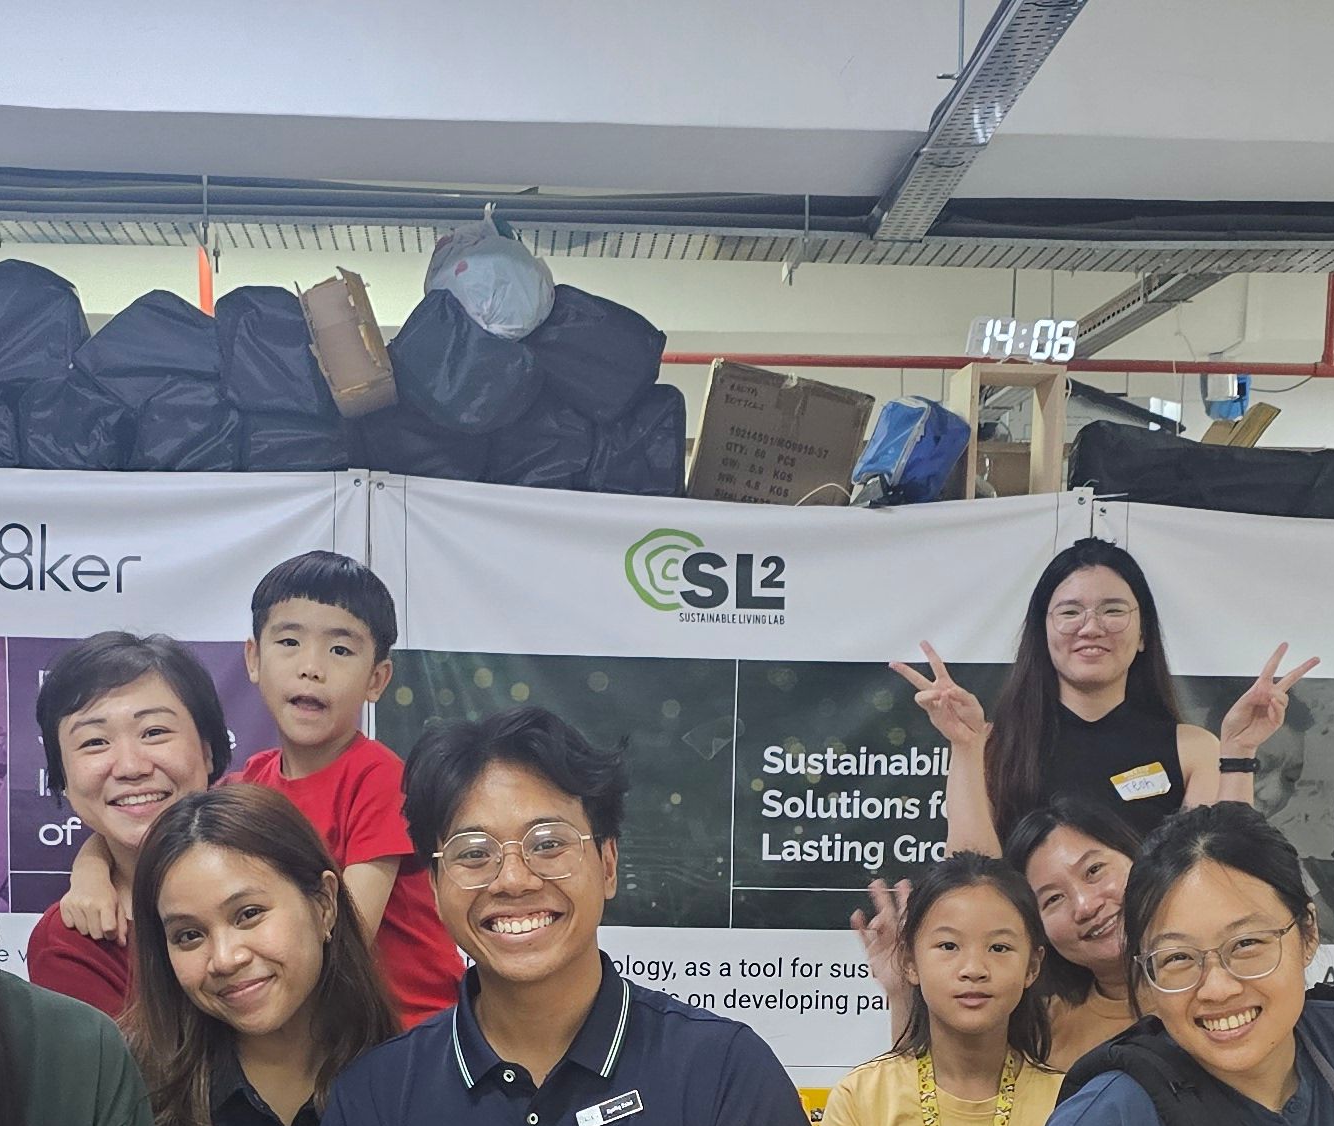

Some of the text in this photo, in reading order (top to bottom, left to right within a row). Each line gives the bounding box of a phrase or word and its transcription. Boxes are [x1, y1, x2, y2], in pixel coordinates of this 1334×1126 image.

[982, 318, 1078, 362] 14:06
[678, 612, 786, 625] SUSTAINABLE LIVING LAB
[761, 789, 921, 820] Solutions
[38, 816, 82, 846] of
[761, 832, 885, 870] Lasting
[684, 960, 712, 978] as
[718, 961, 732, 978] a
[739, 956, 783, 979] tool
[790, 956, 823, 979] for
[687, 993, 715, 1009] on
[723, 987, 849, 1015] developing
